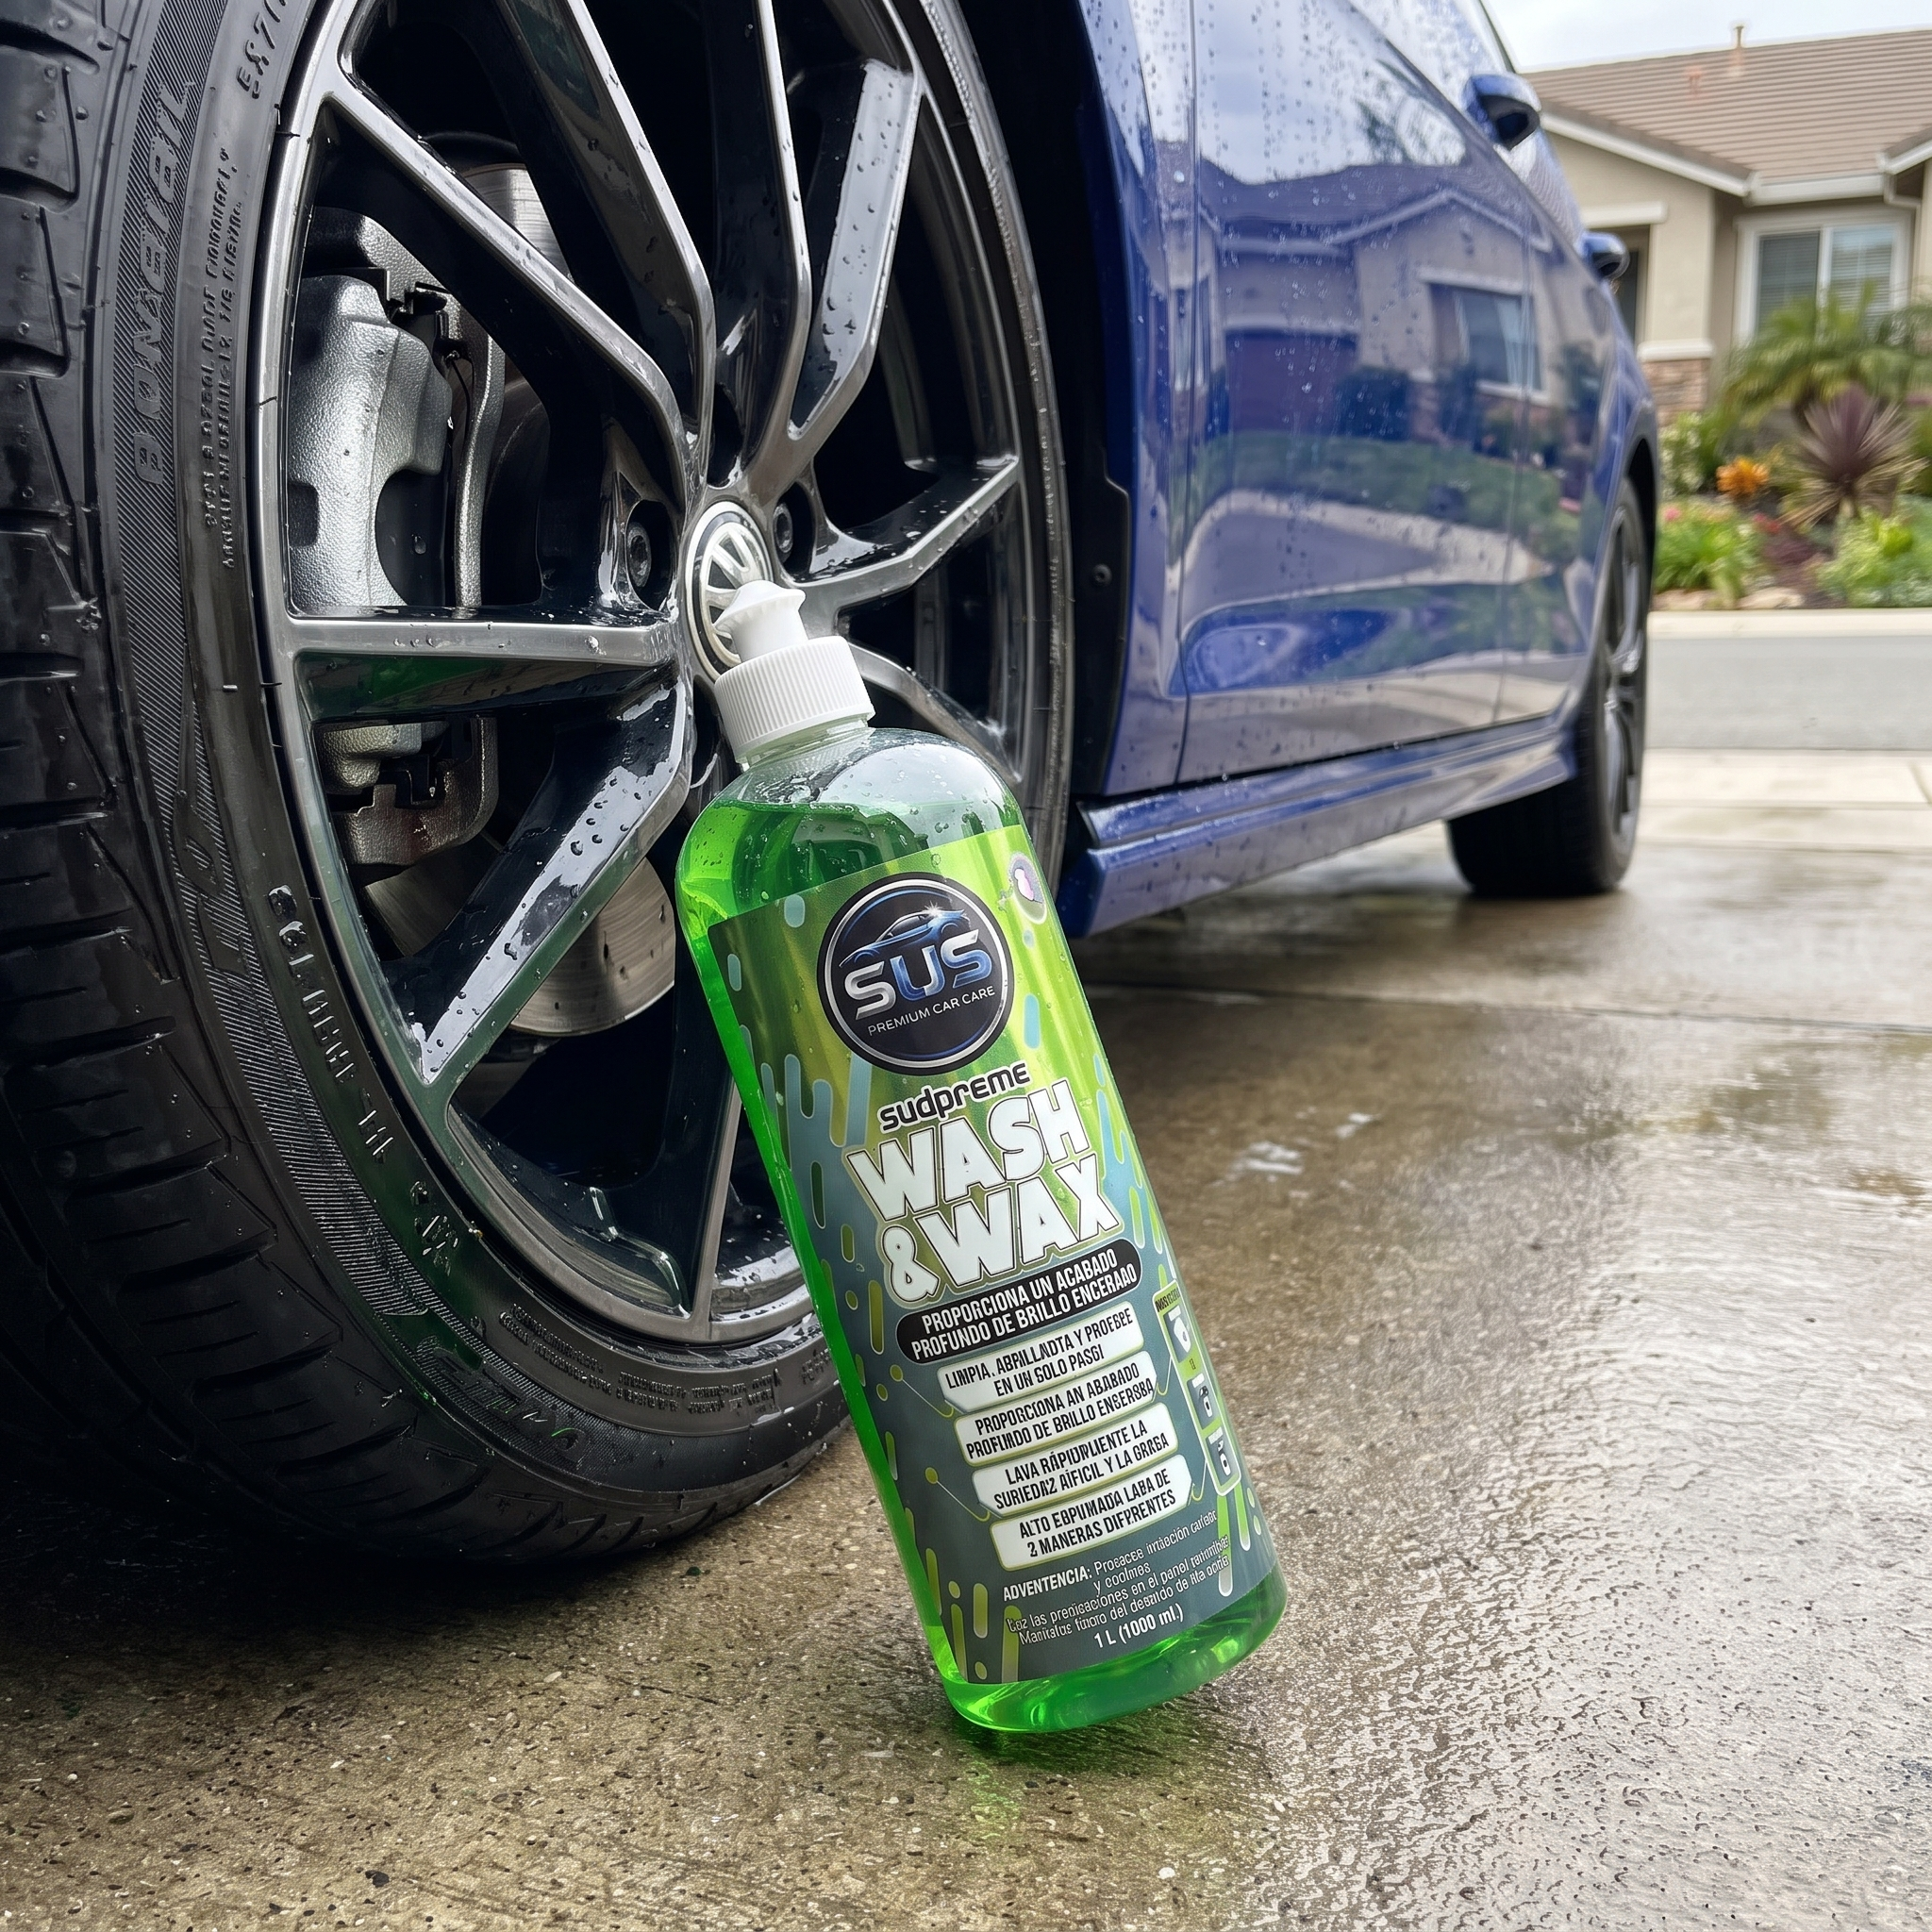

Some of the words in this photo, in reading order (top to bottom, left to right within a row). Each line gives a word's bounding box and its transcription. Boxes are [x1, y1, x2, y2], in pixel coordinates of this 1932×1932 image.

[844, 929, 993, 1021] SUS
[867, 1007, 931, 1037] PREMIUM
[932, 995, 960, 1017] CAR
[961, 985, 996, 1007] CARE
[847, 1080, 1091, 1221] WASH
[921, 1285, 1030, 1334] PROPORCIONA
[1028, 1274, 1054, 1299] UN
[1056, 1248, 1117, 1291] ACABADO
[910, 1321, 991, 1359] PROFUNDO
[991, 1312, 1015, 1336] DE
[1014, 1292, 1071, 1328] BRILLO
[1073, 1328, 1082, 1345] Y
[993, 1376, 1013, 1396] EN
[1013, 1370, 1034, 1390] UN
[1066, 1385, 1085, 1407] AN
[1031, 1420, 1052, 1440] DE
[1052, 1404, 1095, 1433] BRILLO
[1005, 1461, 1040, 1485] LAVA
[1130, 1419, 1147, 1439] LA
[1103, 1456, 1113, 1473] Y
[1114, 1449, 1133, 1469] LA
[1154, 1468, 1170, 1488] DE
[1038, 1521, 1103, 1555] MANERAS
[1004, 1565, 1091, 1601] ADVENTENCIA:
[1029, 1613, 1047, 1626] las
[1130, 1581, 1145, 1595] en
[1147, 1572, 1158, 1588] el
[1159, 1557, 1189, 1584] panel
[1092, 1580, 1100, 1596] y
[1109, 1602, 1127, 1620] del
[1175, 1578, 1189, 1592] de
[1093, 1632, 1103, 1647] 1
[1105, 1629, 1116, 1644] L
[1118, 1613, 1156, 1643] (1000
[1158, 1603, 1183, 1624] ml.)
